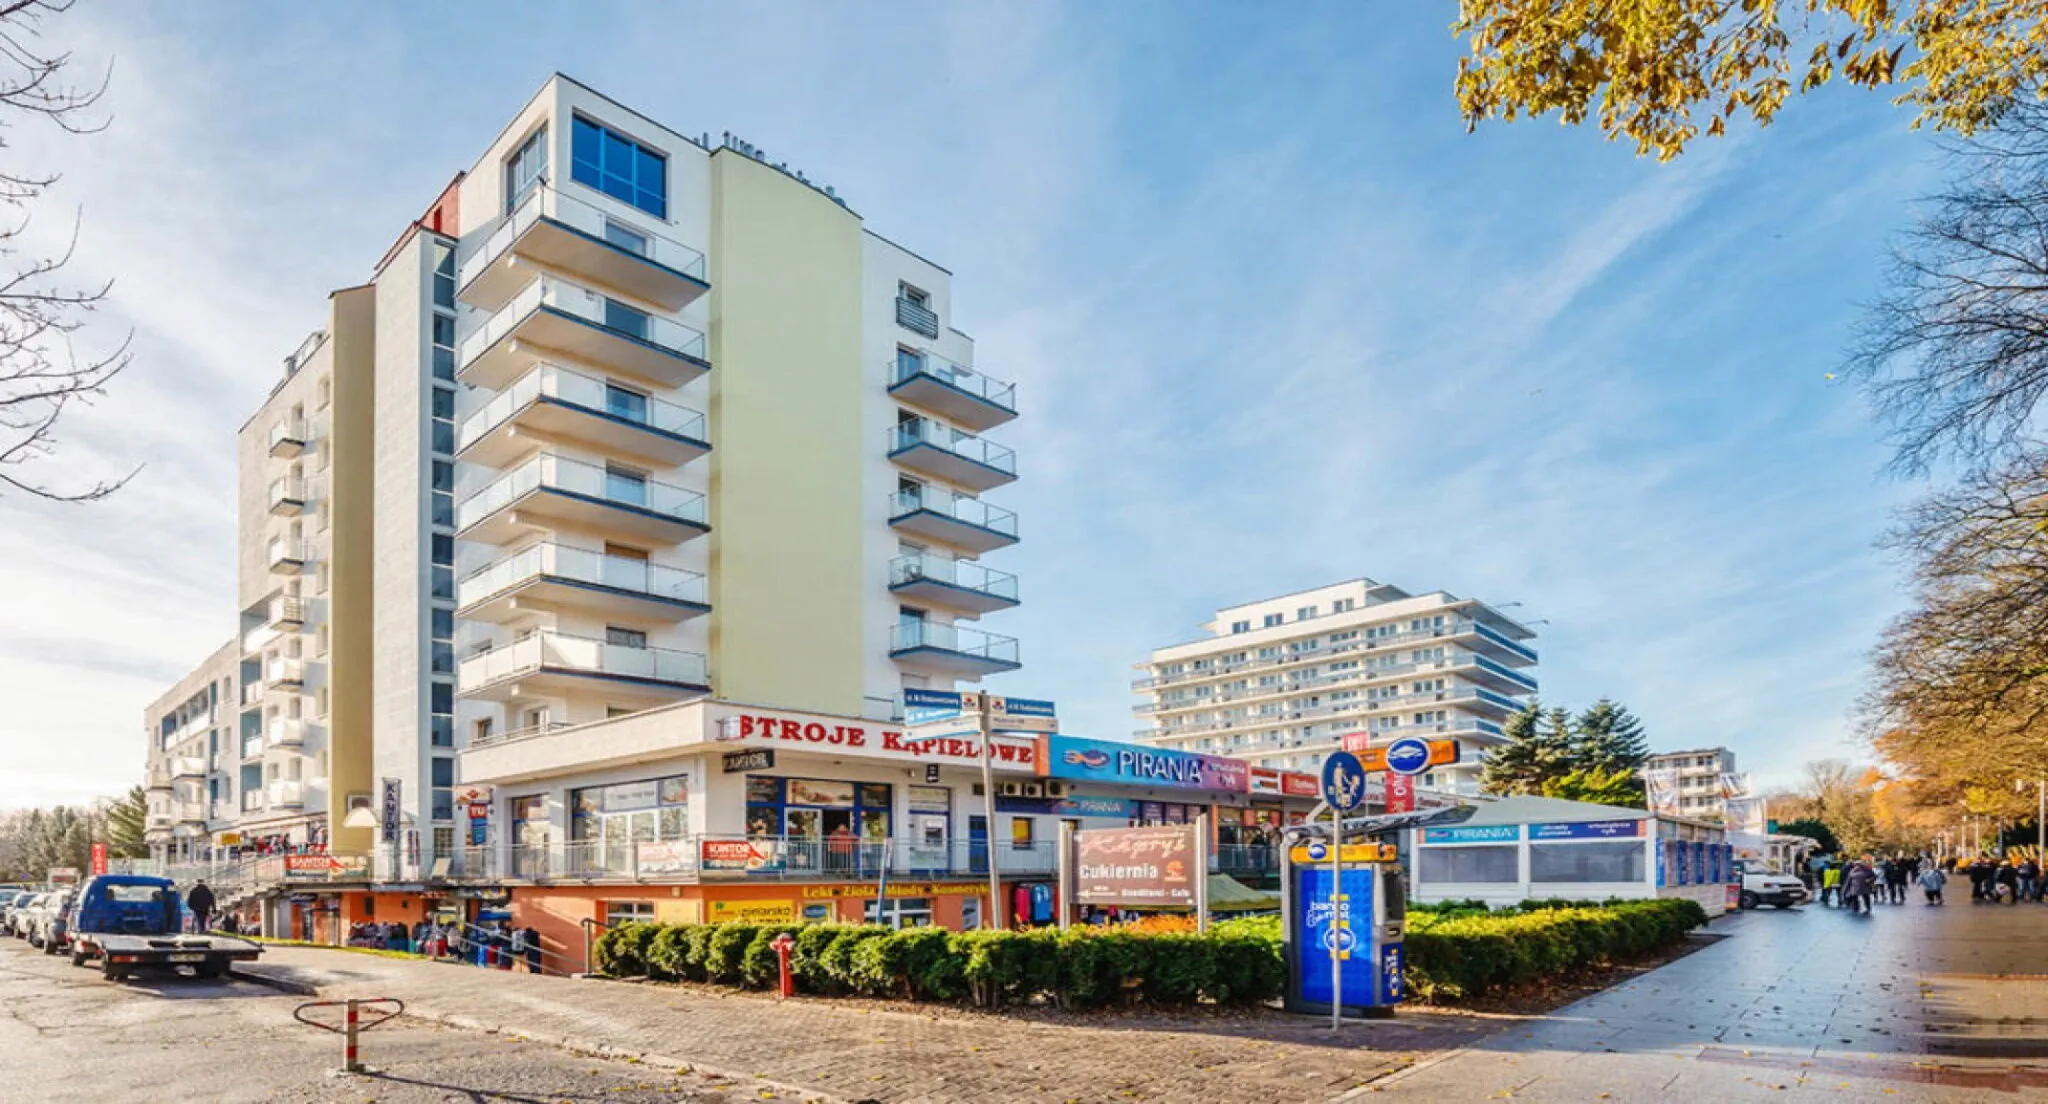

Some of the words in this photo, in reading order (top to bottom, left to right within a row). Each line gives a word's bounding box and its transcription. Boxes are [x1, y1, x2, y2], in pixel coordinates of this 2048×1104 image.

[739, 714, 866, 748] STROJE
[1117, 749, 1203, 783] PIRANIA
[1079, 863, 1158, 879] Cukiernia
